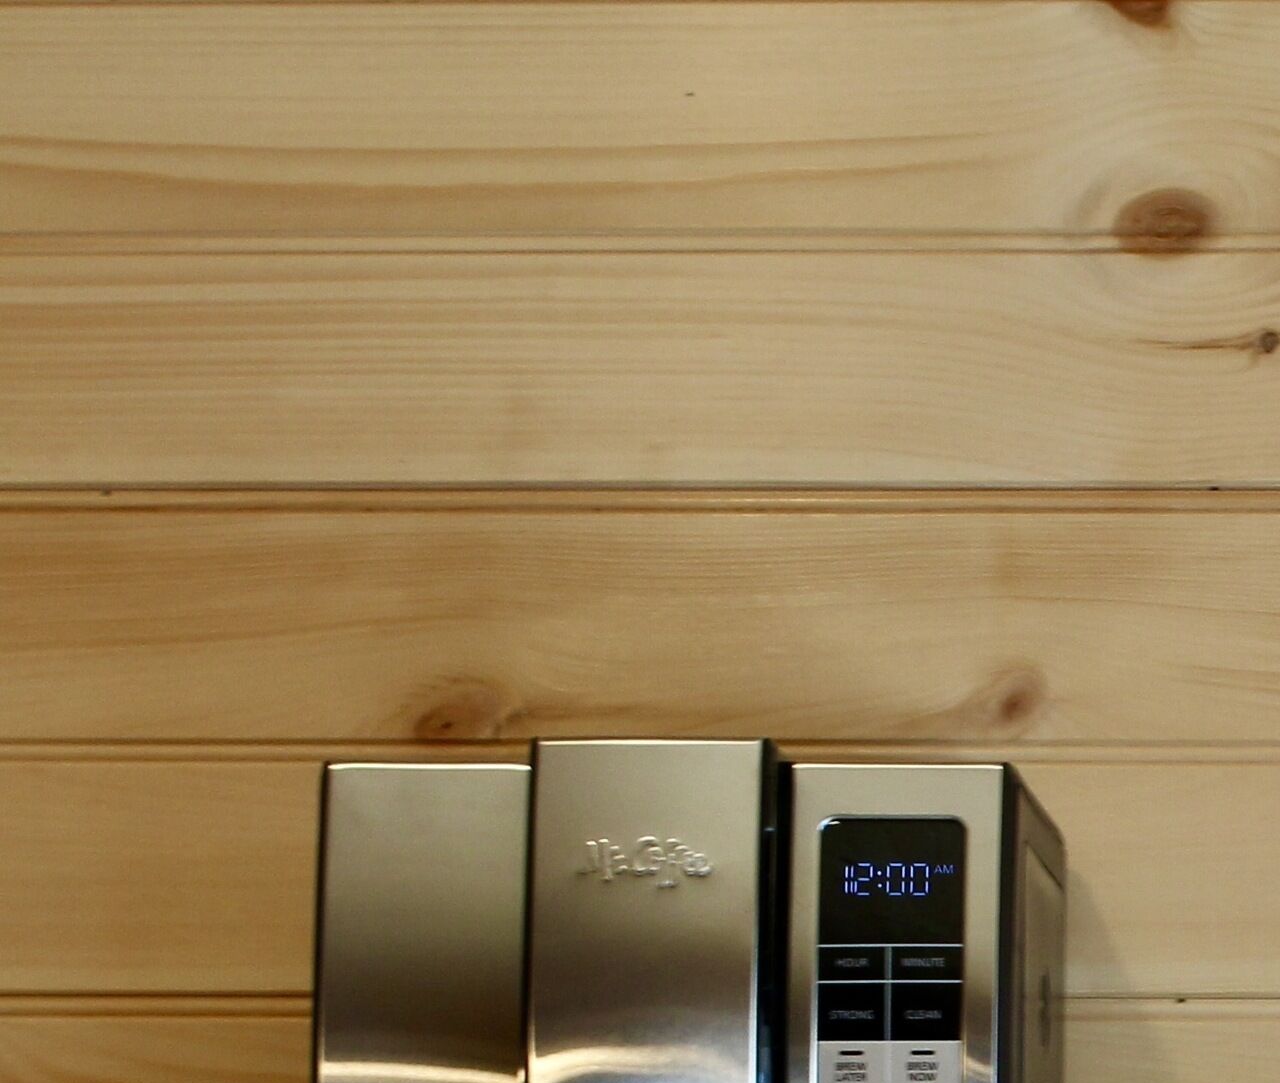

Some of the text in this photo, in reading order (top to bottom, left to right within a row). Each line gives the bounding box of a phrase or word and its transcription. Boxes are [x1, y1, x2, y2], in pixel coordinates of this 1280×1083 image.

[844, 862, 954, 897] 12:00 AM
[835, 958, 869, 968] HOUR
[901, 957, 945, 968] MINUTE
[828, 1010, 876, 1020] STRONG
[904, 1010, 942, 1020] CLEAN
[833, 1062, 867, 1072] BREW
[906, 1061, 939, 1072] BREW
[834, 1072, 867, 1082] LATER
[907, 1072, 937, 1082] NOW
